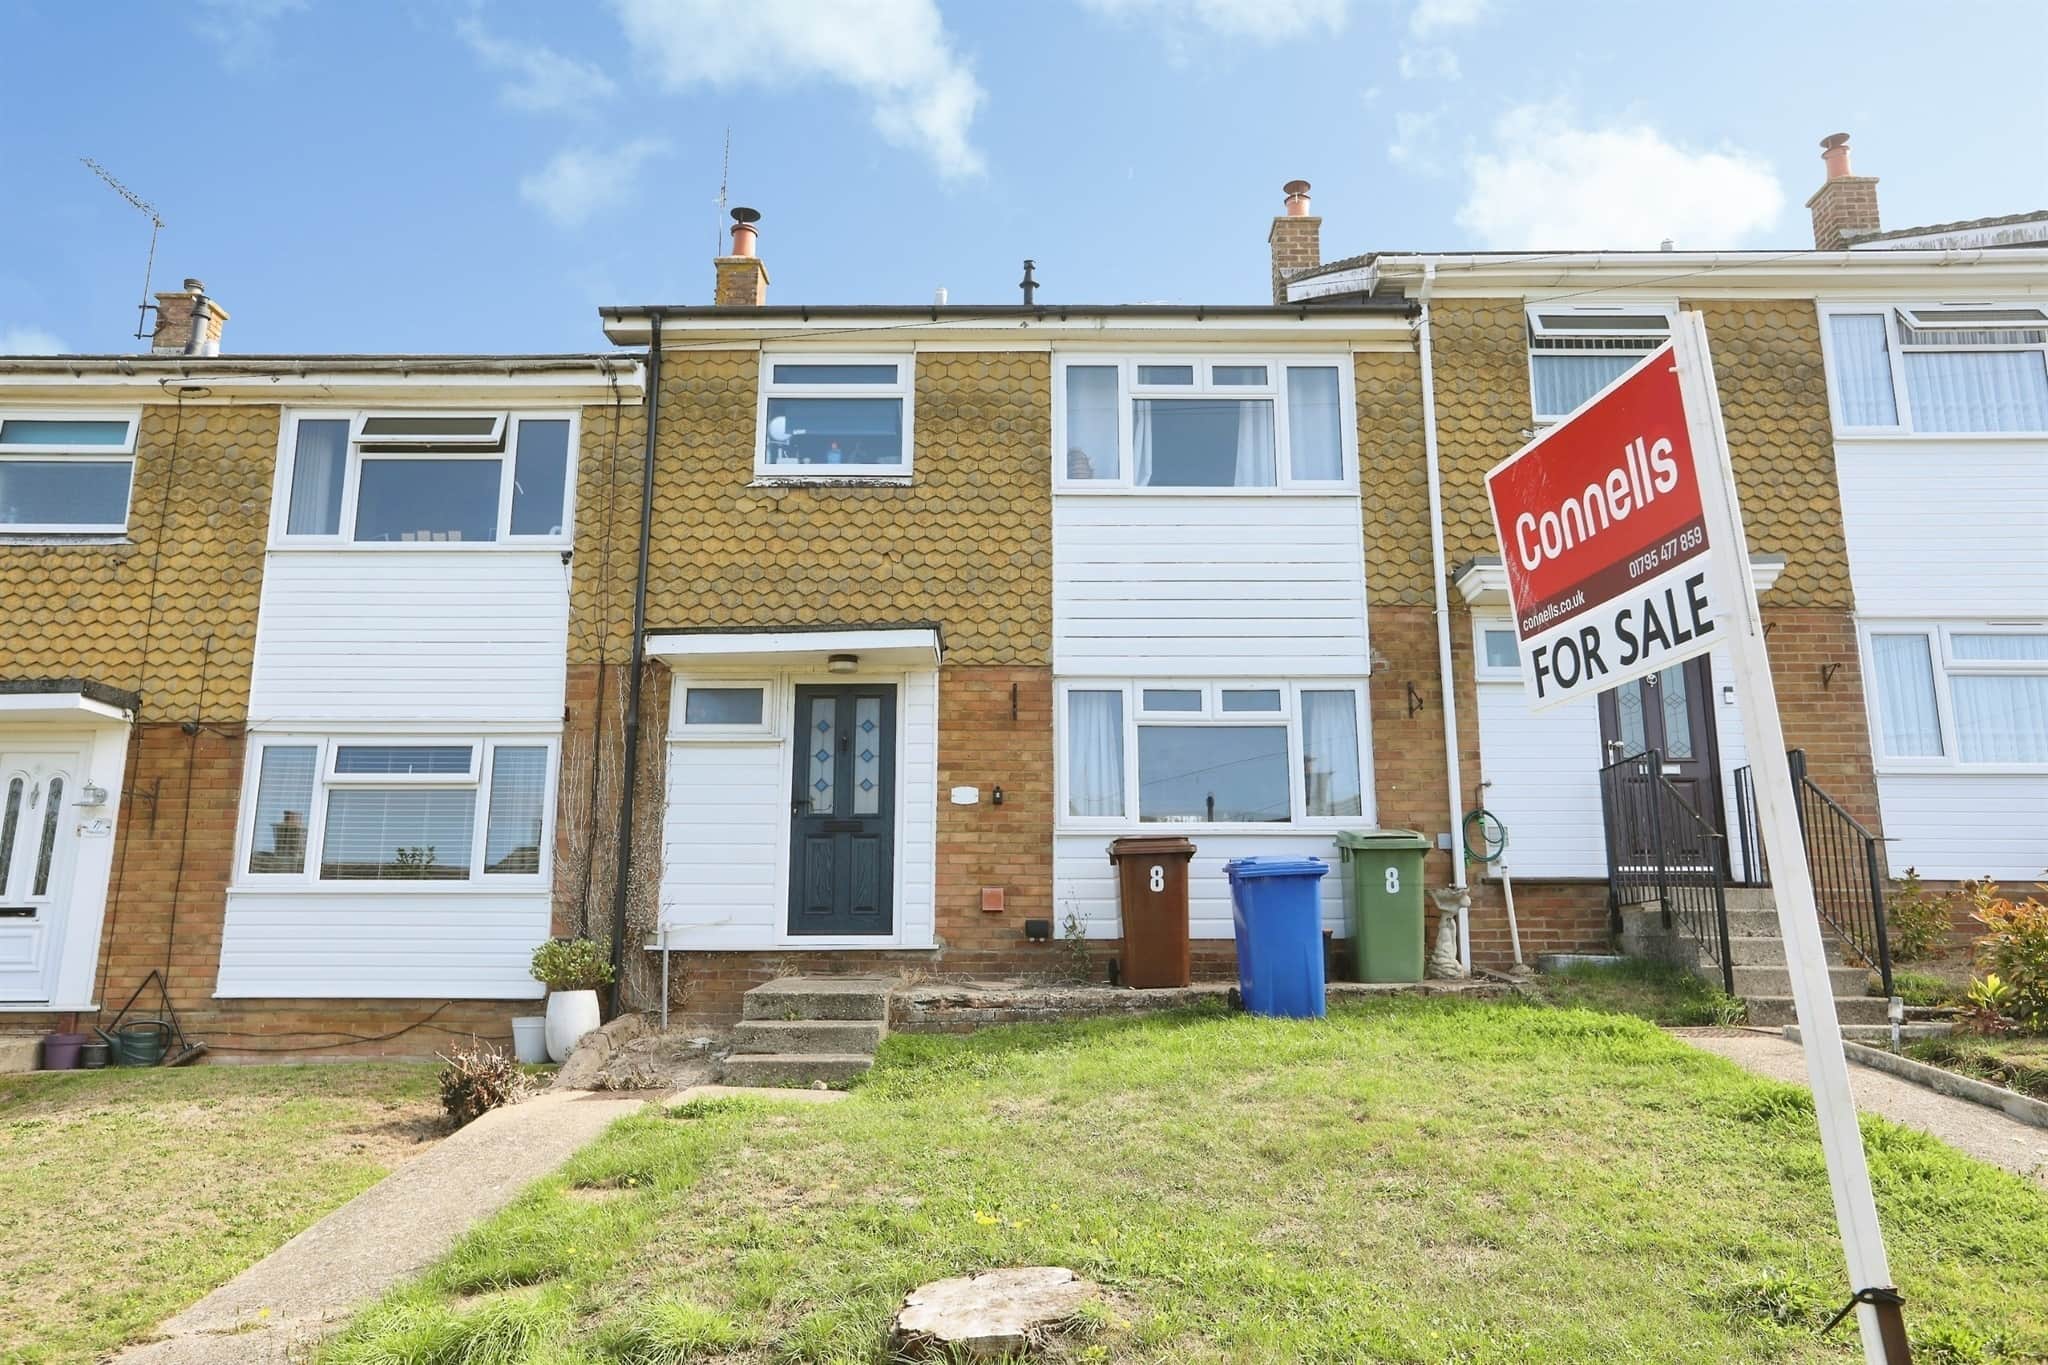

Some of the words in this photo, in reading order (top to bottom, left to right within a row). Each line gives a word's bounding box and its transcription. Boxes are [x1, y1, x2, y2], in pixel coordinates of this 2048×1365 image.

[1515, 436, 1678, 571] Connells
[1629, 549, 1659, 579] 01795
[1660, 536, 1678, 562] 477
[1680, 526, 1703, 552] 859
[1522, 590, 1586, 632] connells.co.uk
[1532, 625, 1608, 698] FOR
[1614, 572, 1715, 667] SALE
[1150, 865, 1164, 892] 8
[1385, 867, 1400, 894] 8
